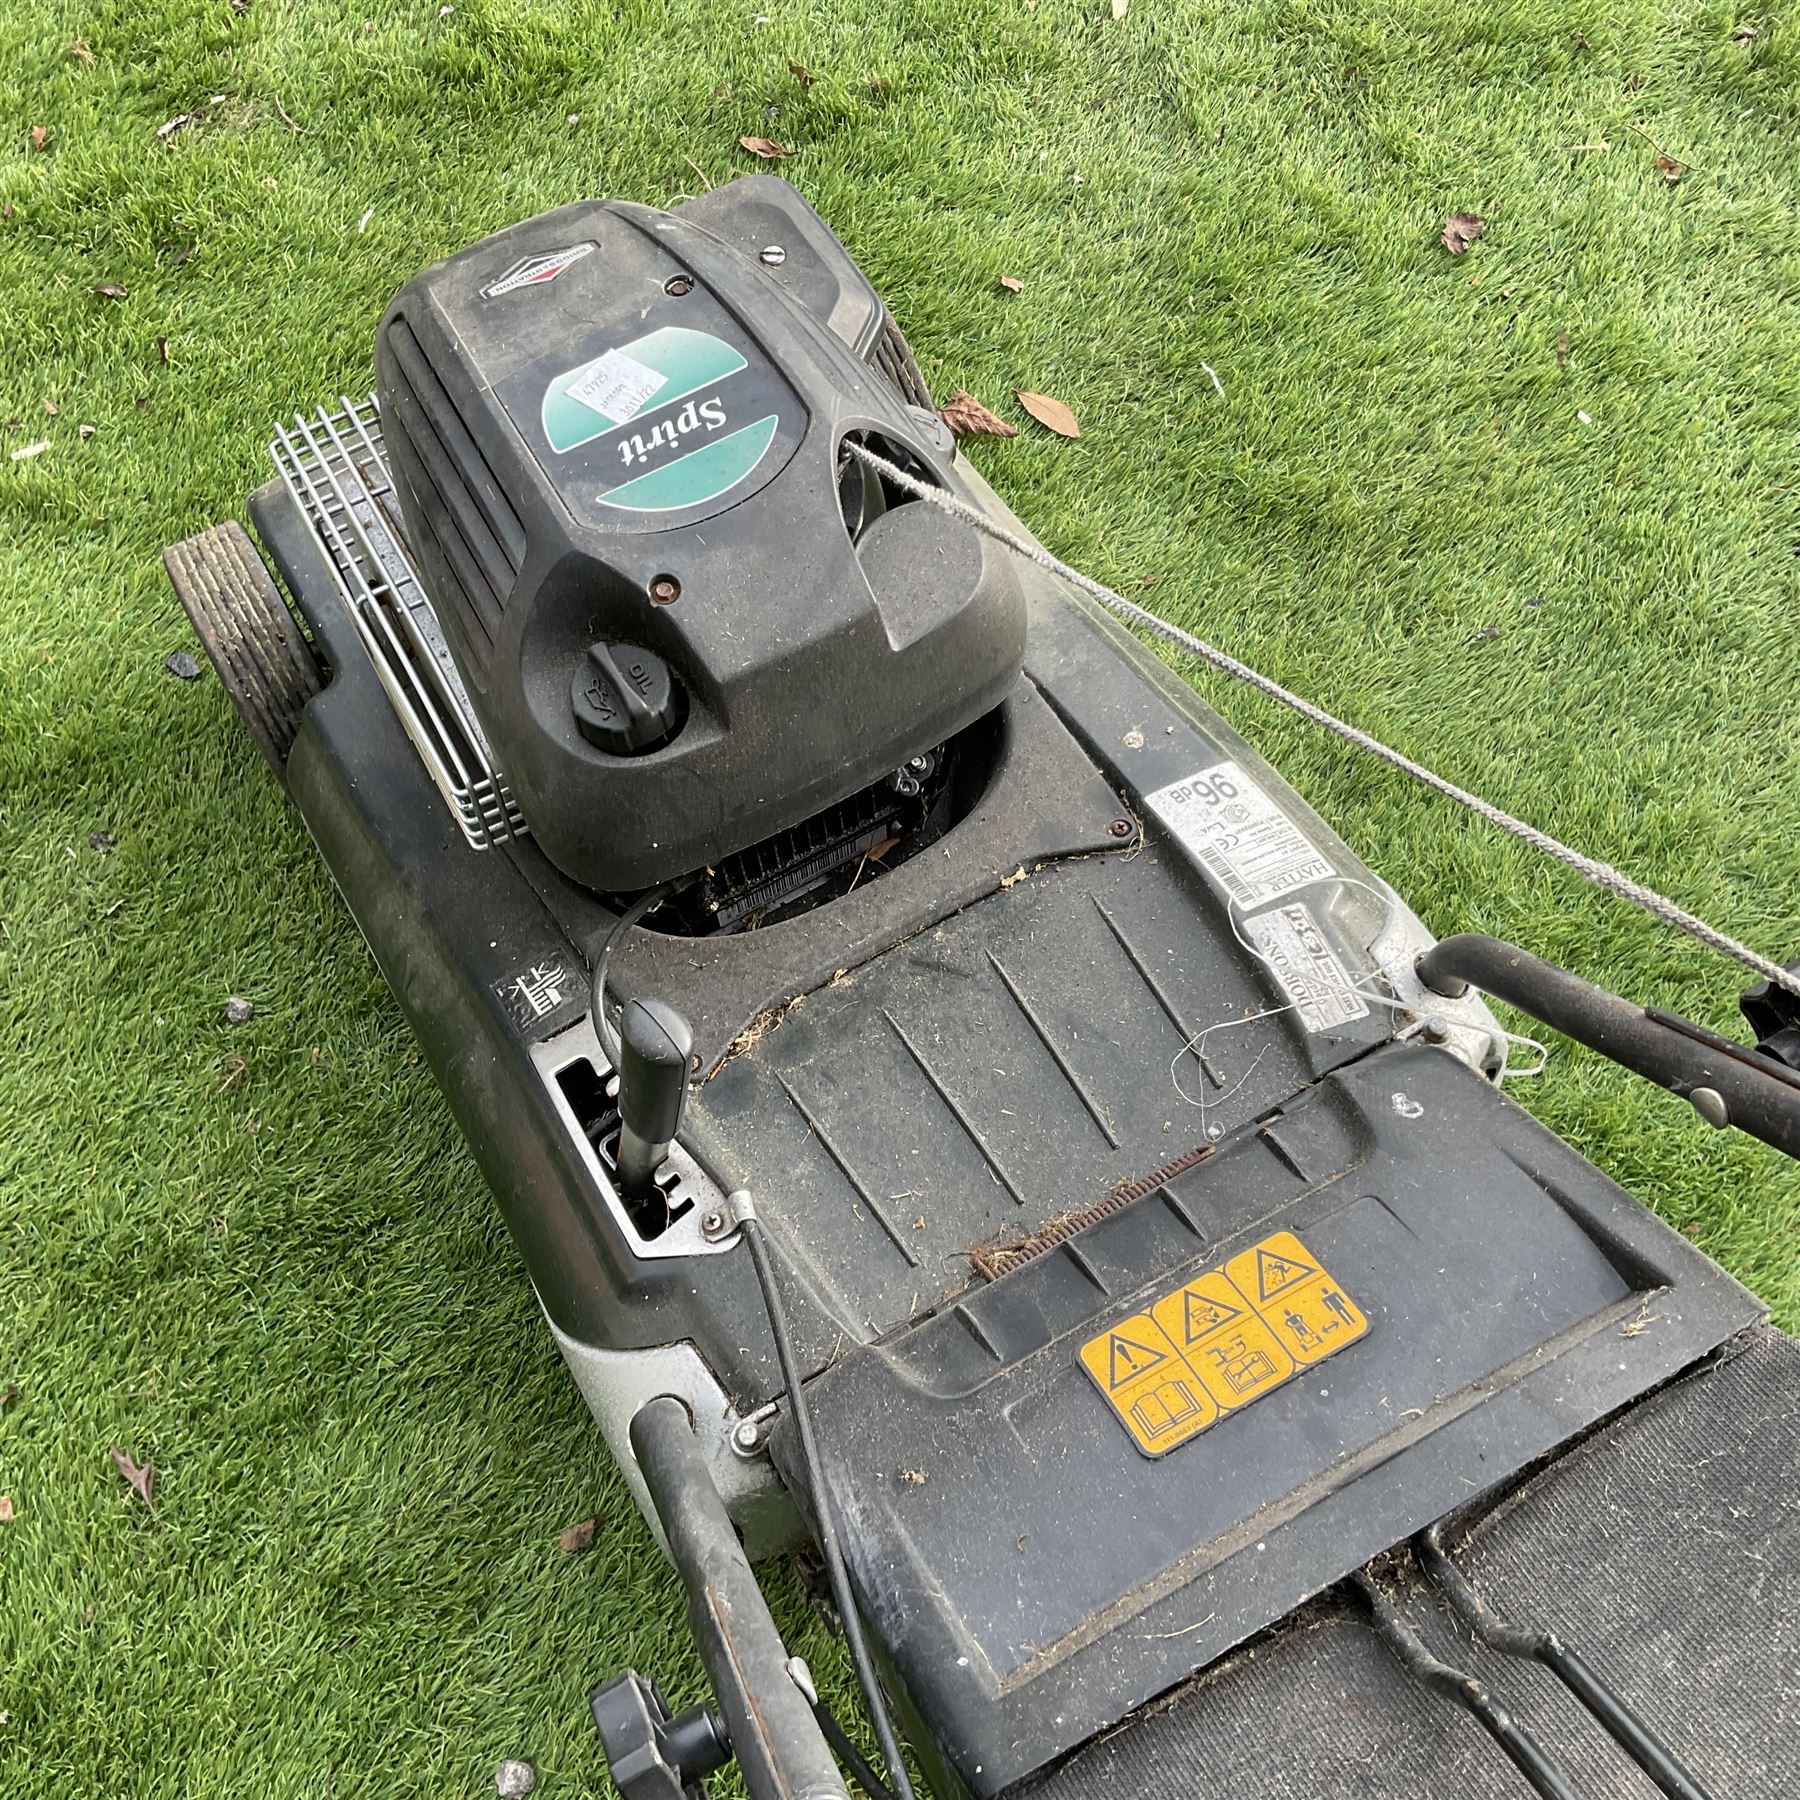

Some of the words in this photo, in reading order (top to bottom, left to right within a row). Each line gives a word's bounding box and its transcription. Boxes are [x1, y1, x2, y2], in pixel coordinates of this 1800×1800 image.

[617, 396, 727, 466] Spirit
[629, 664, 653, 695] OIL
[1170, 785, 1193, 804] dB
[1193, 772, 1239, 807] 96
[1271, 861, 1329, 893] HAYTER
